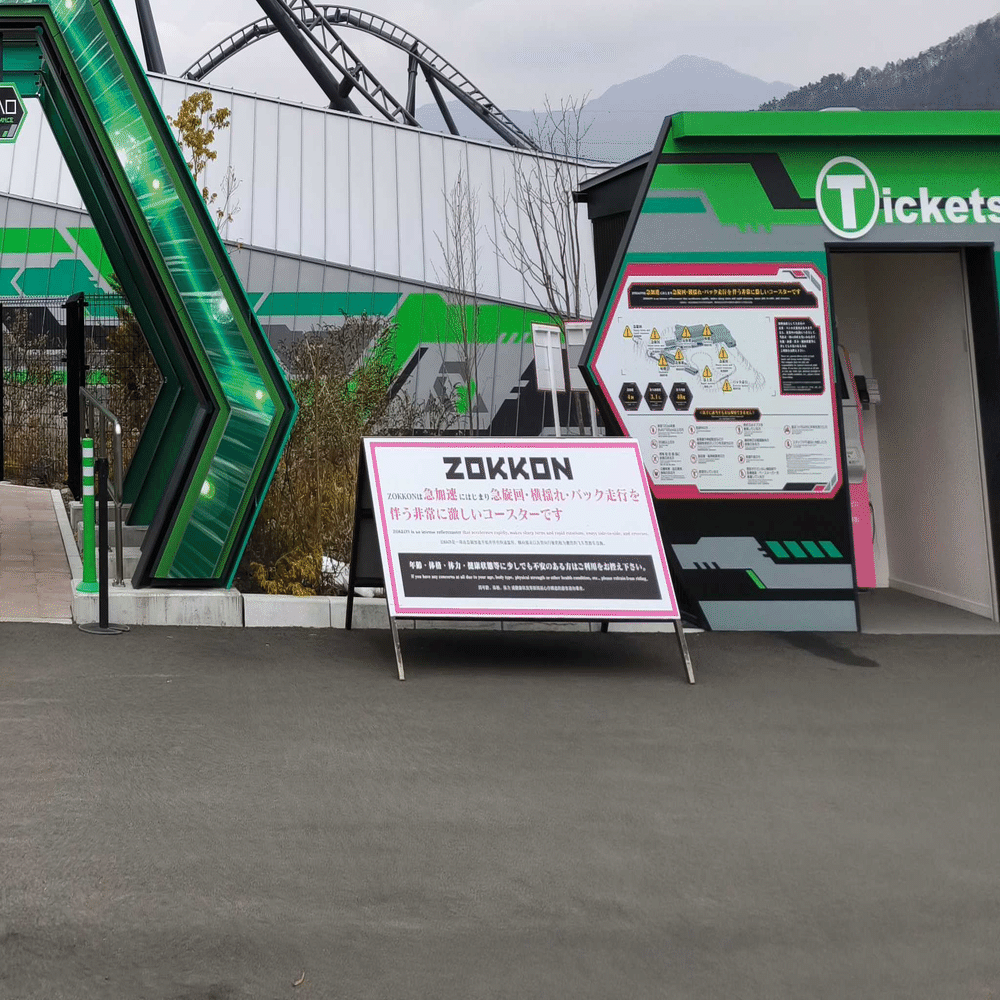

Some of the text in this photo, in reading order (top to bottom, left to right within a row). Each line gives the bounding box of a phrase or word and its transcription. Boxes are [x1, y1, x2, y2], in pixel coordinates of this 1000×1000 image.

[443, 457, 574, 480] ZOKKON
[390, 507, 563, 521] 伴う非常に激しいコースターです
